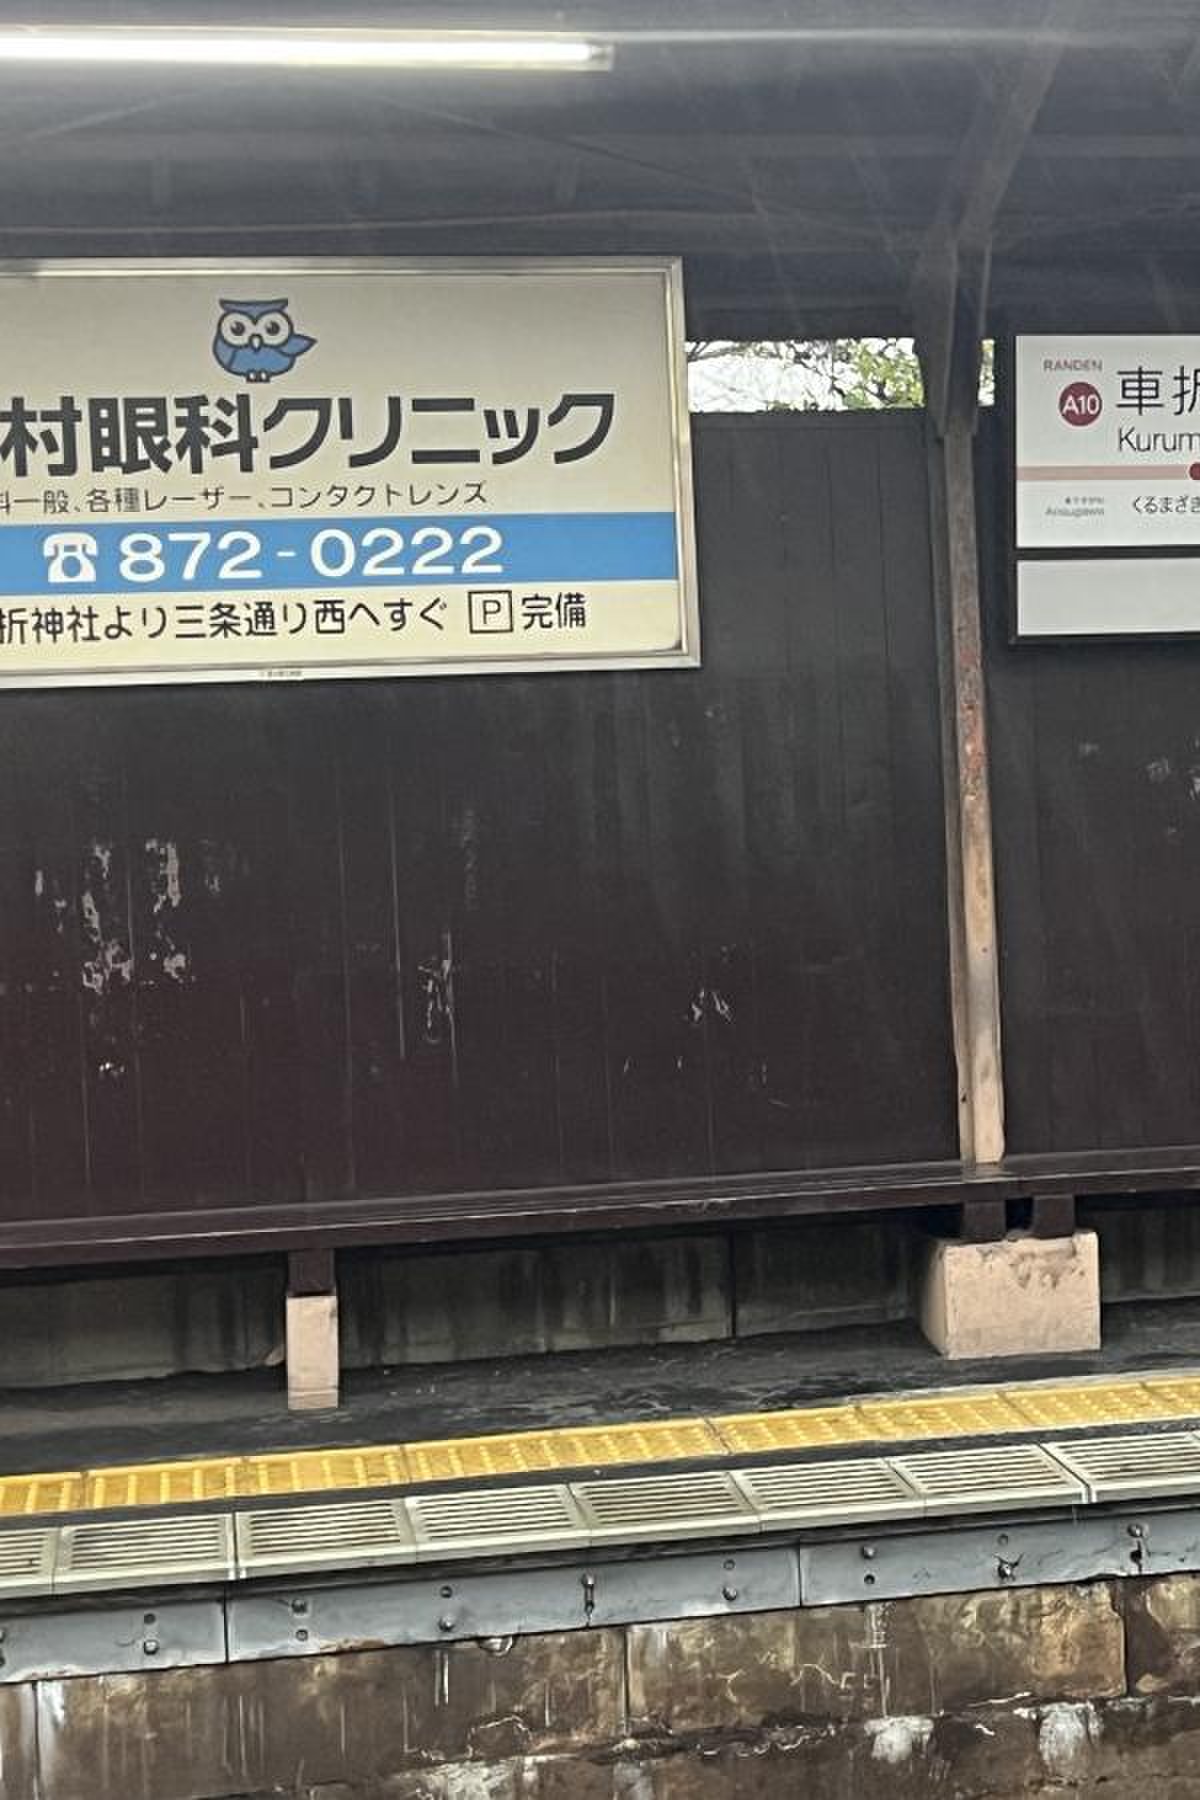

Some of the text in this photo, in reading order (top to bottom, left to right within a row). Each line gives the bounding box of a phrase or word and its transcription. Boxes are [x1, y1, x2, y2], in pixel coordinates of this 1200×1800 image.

[1043, 359, 1103, 372] RANDEN
[1062, 394, 1100, 415] A10
[0, 393, 614, 478] 村眼科クリニック
